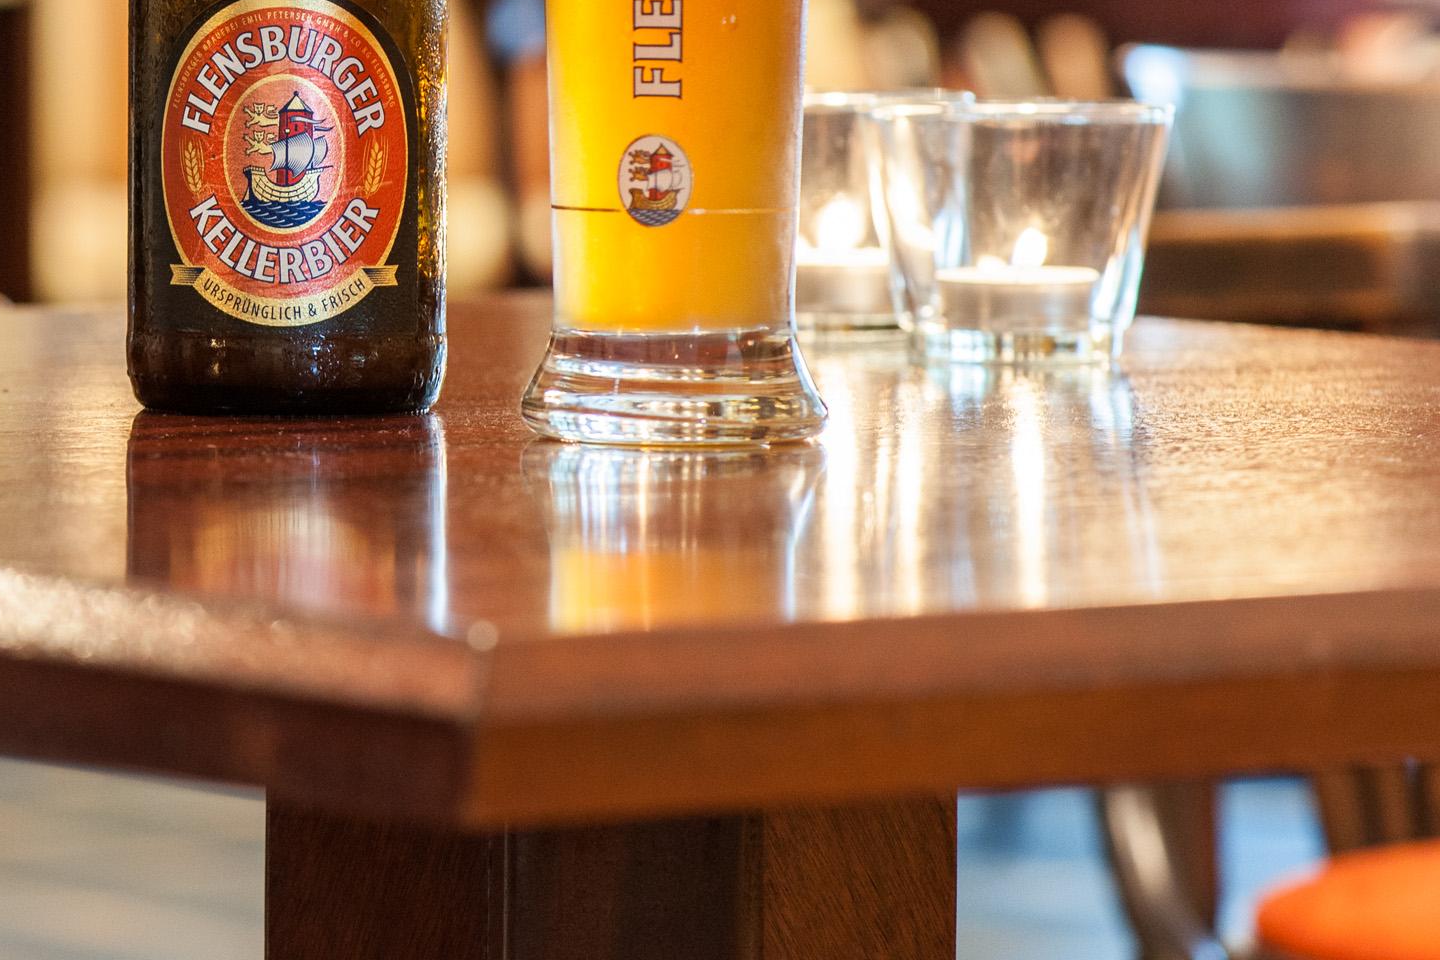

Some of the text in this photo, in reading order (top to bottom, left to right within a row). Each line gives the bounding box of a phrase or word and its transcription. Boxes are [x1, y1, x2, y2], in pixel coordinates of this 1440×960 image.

[182, 26, 385, 136] FLENSBURGER
[190, 195, 380, 284] KELLERBIER
[203, 277, 366, 321] URSPRÜNGLICH & FRISCH
